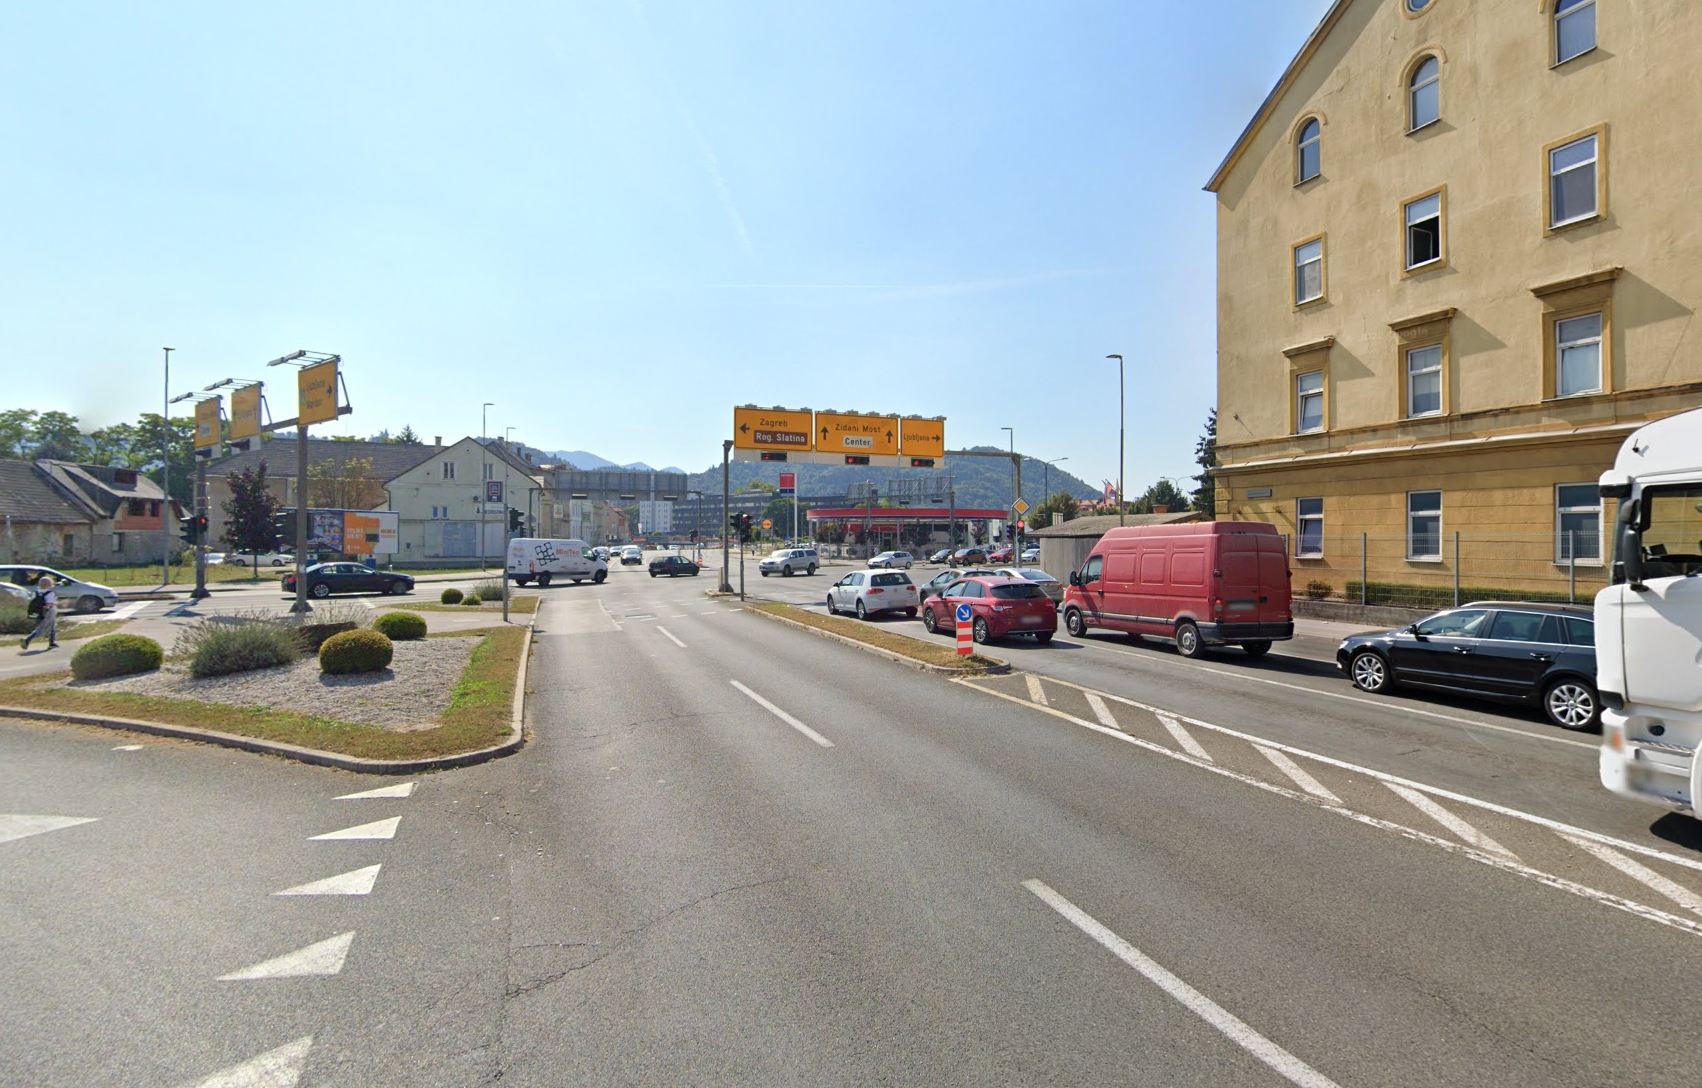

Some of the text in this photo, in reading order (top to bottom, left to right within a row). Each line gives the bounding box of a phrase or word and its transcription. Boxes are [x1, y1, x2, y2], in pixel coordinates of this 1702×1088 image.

[760, 418, 788, 428] Zagreb
[835, 423, 881, 433] Zidani Most
[756, 432, 805, 442] Rog. Slatina
[845, 437, 871, 446] Center
[903, 433, 930, 442] Ljubljana
[556, 548, 580, 556] MiniTec
